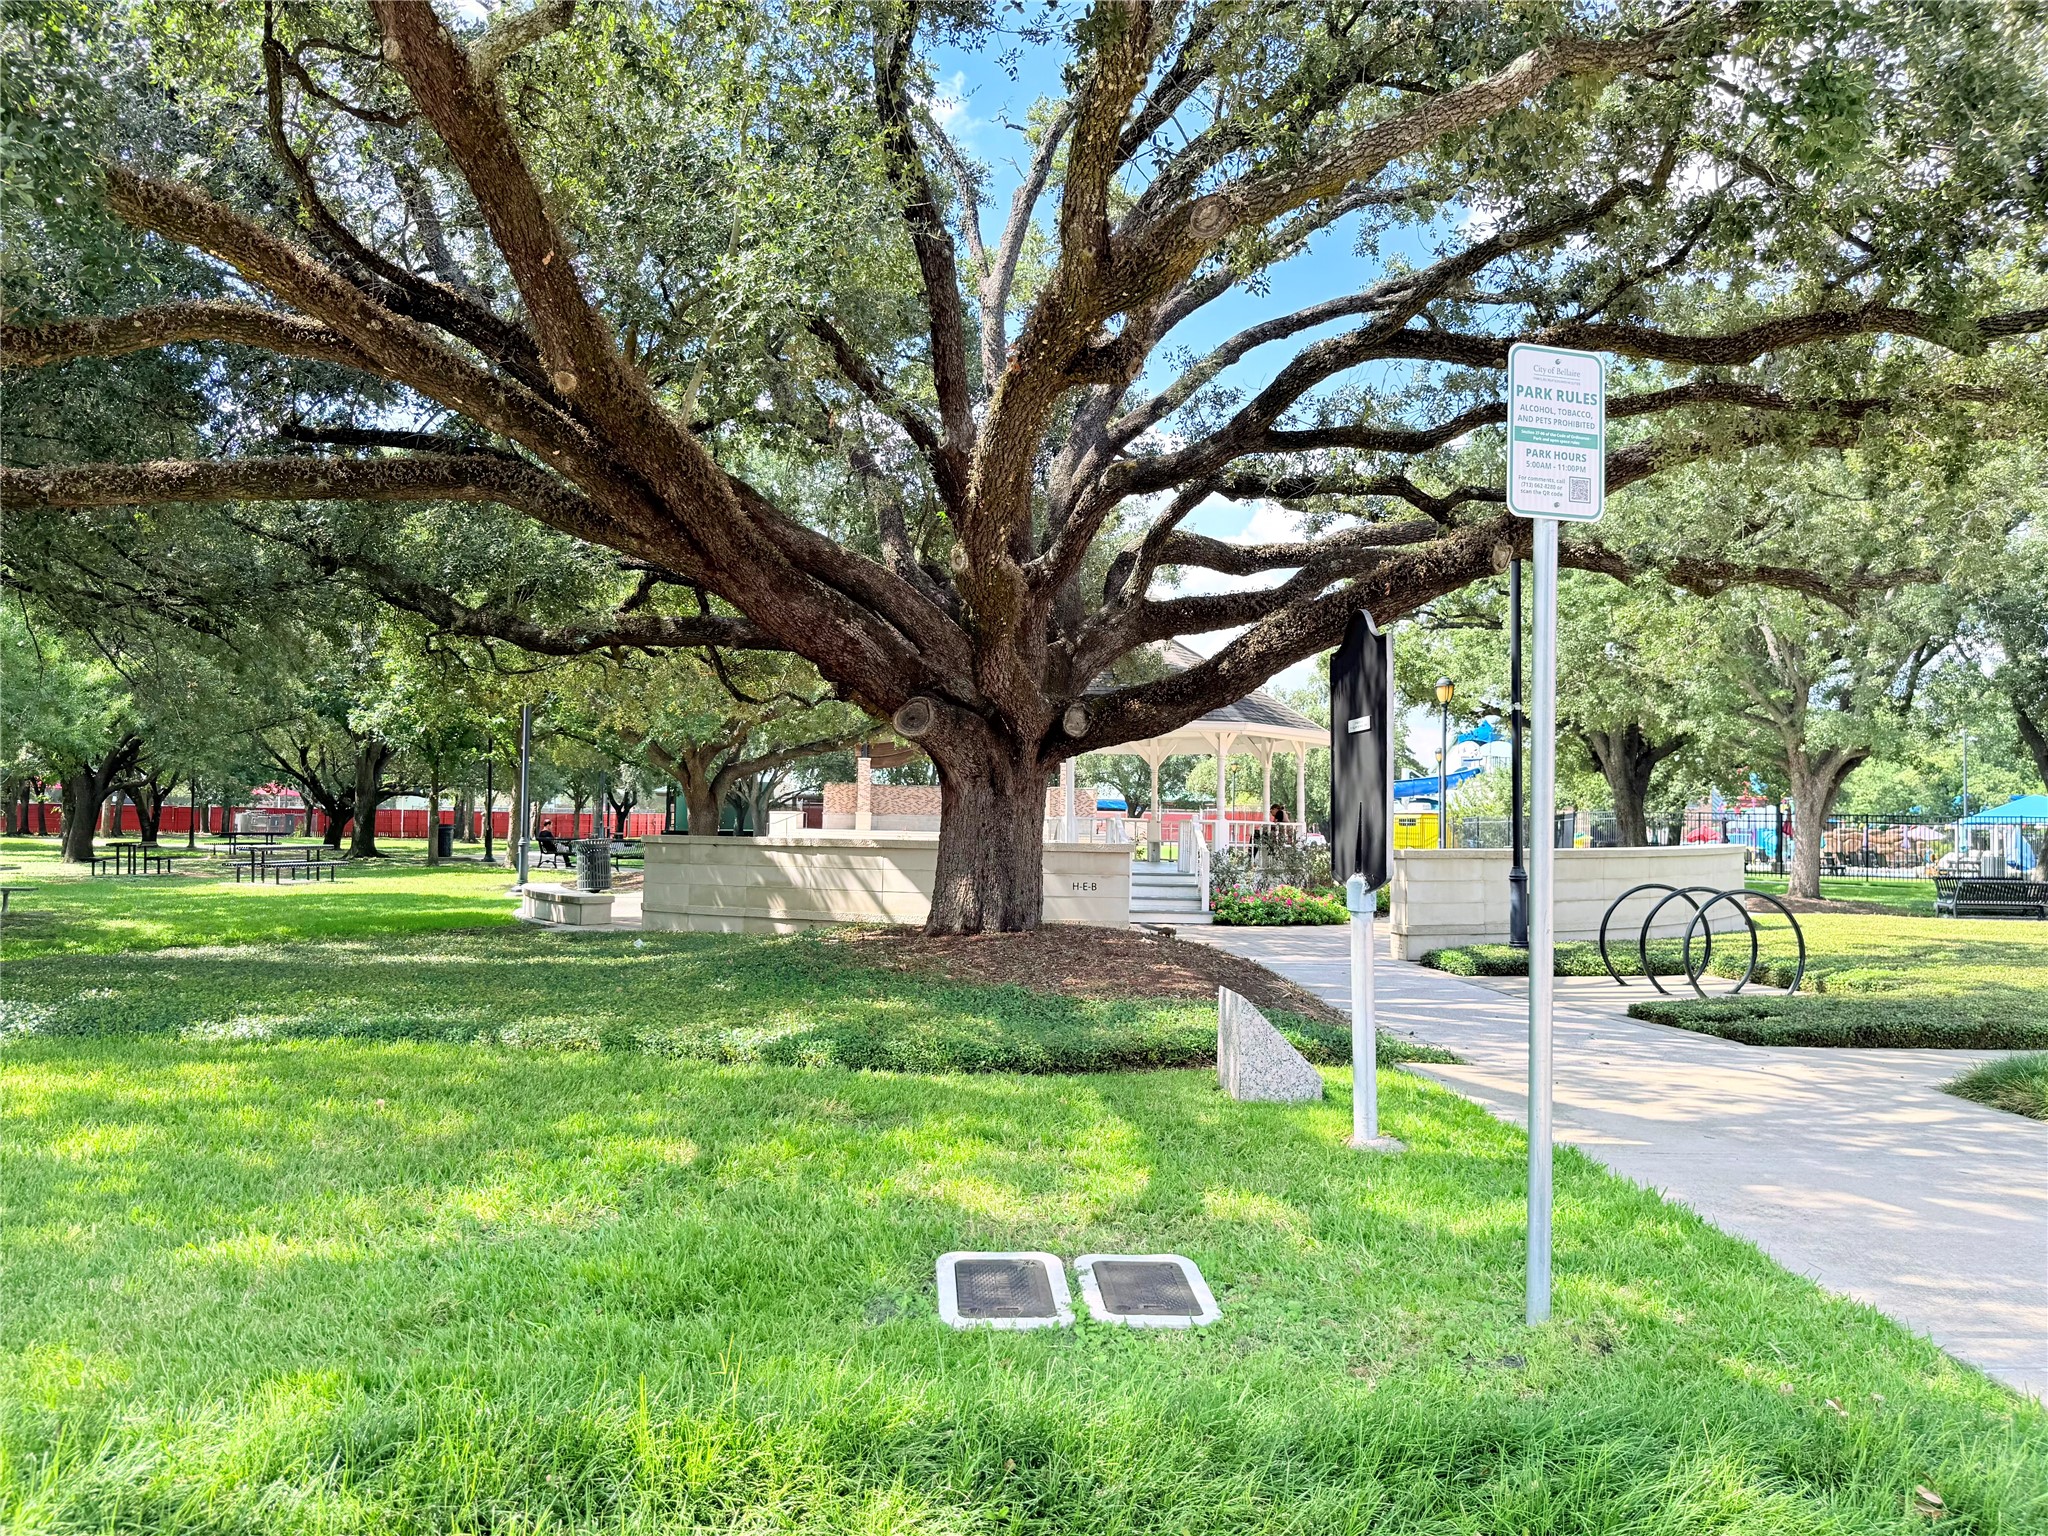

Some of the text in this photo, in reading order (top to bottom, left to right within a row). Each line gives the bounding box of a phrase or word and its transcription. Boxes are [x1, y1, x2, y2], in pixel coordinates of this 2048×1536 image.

[1533, 364, 1546, 375] City
[1516, 384, 1598, 406] PARK RULES
[1520, 403, 1593, 420] ALCOHOL, TOBACCO,
[1517, 414, 1596, 430] AND PETS PROHIBITED
[1525, 448, 1587, 463] PARK HOURS
[1525, 460, 1552, 470] 5:00AM
[1558, 464, 1587, 473] 11:00PM
[1072, 882, 1097, 891] H-E-B
